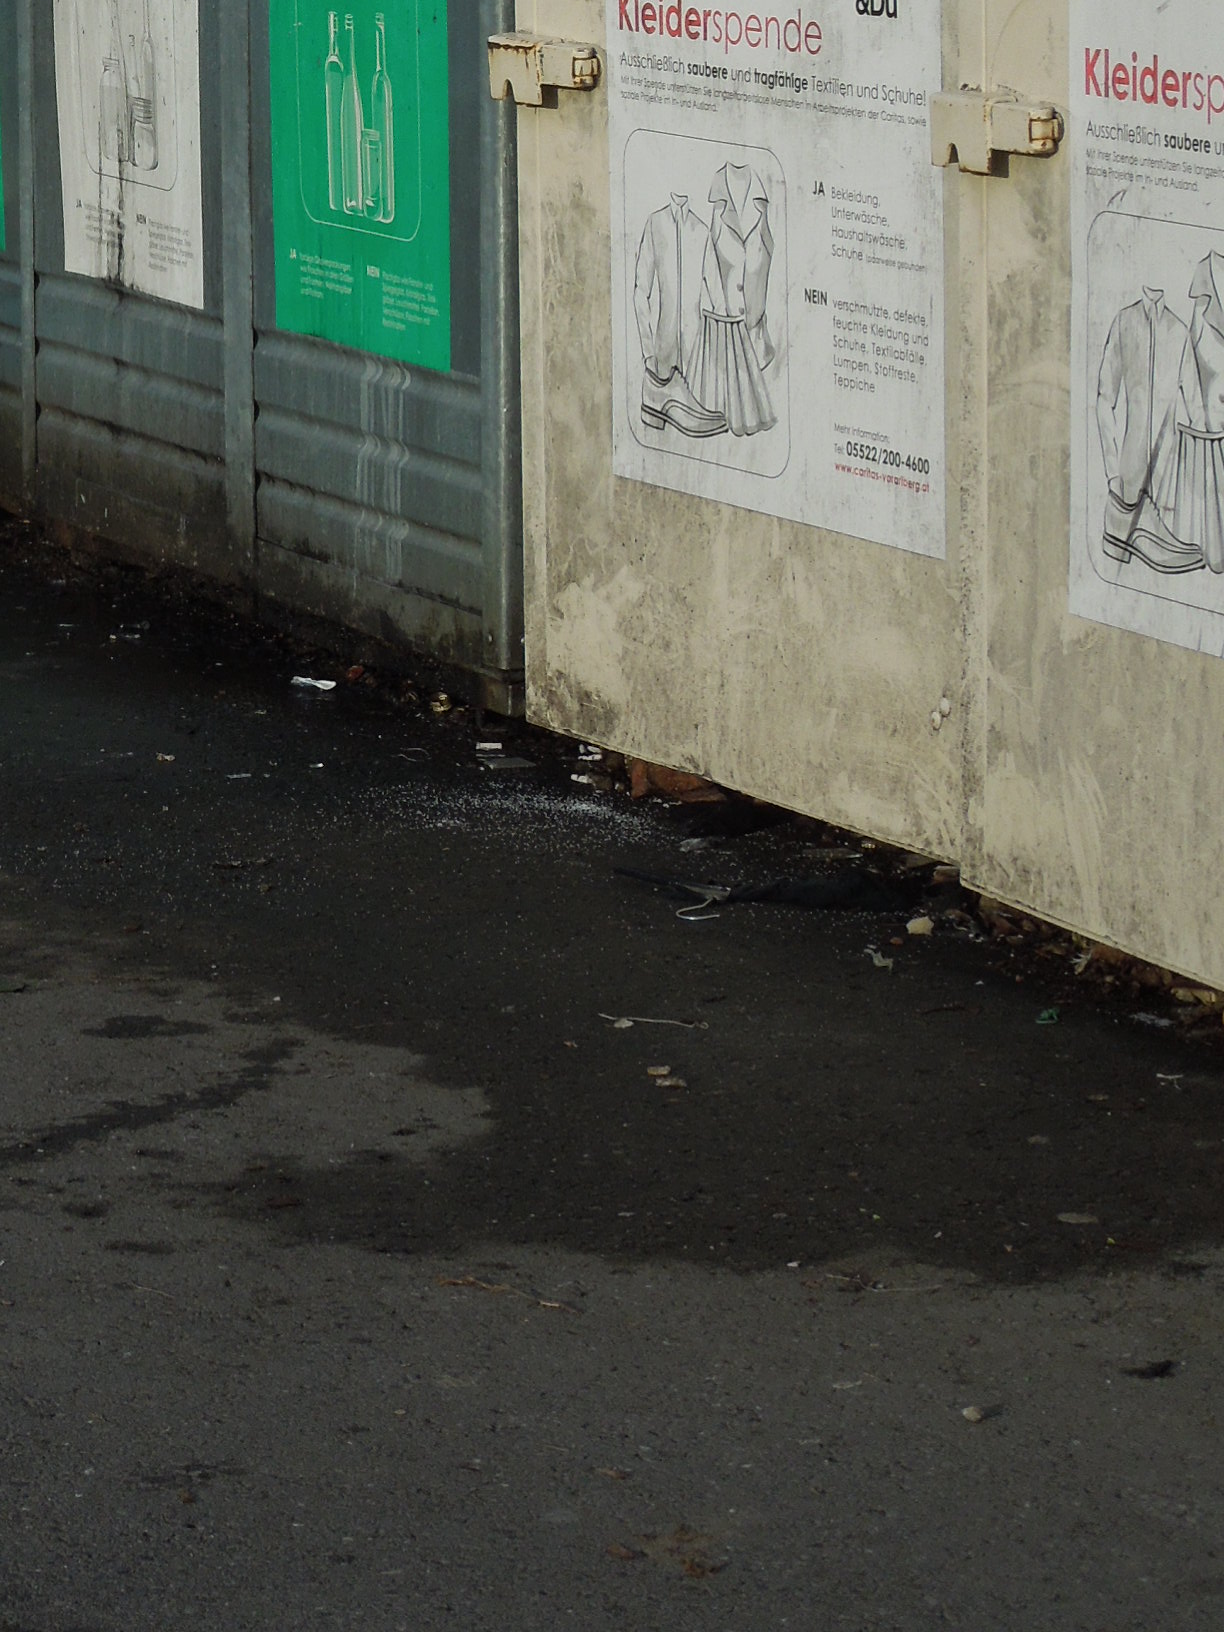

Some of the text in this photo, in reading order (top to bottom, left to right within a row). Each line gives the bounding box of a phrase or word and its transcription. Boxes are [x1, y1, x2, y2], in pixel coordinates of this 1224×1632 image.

[620, 52, 926, 107] Ausschließlich saubere und tragfähige Textilien und Schuhe!
[908, 115, 926, 127] sowie
[1086, 120, 1161, 147] Ausschließlich
[1164, 132, 1211, 154] saubere
[812, 180, 881, 209] JA Bekleidung,
[831, 206, 890, 228] Unterwäsche,
[831, 225, 908, 250] Haushaltswäsche,
[831, 244, 863, 261] Schuhe
[804, 288, 928, 327] NEIN verschmutzte, defekte,
[832, 315, 929, 347] feuchte Kleidung und
[833, 334, 927, 366] Schuhe, Textilabfälle,
[833, 354, 919, 384] Lumpen, Stoffreste,
[833, 373, 875, 393] Teppiche
[846, 441, 930, 475] 05522/200-4600
